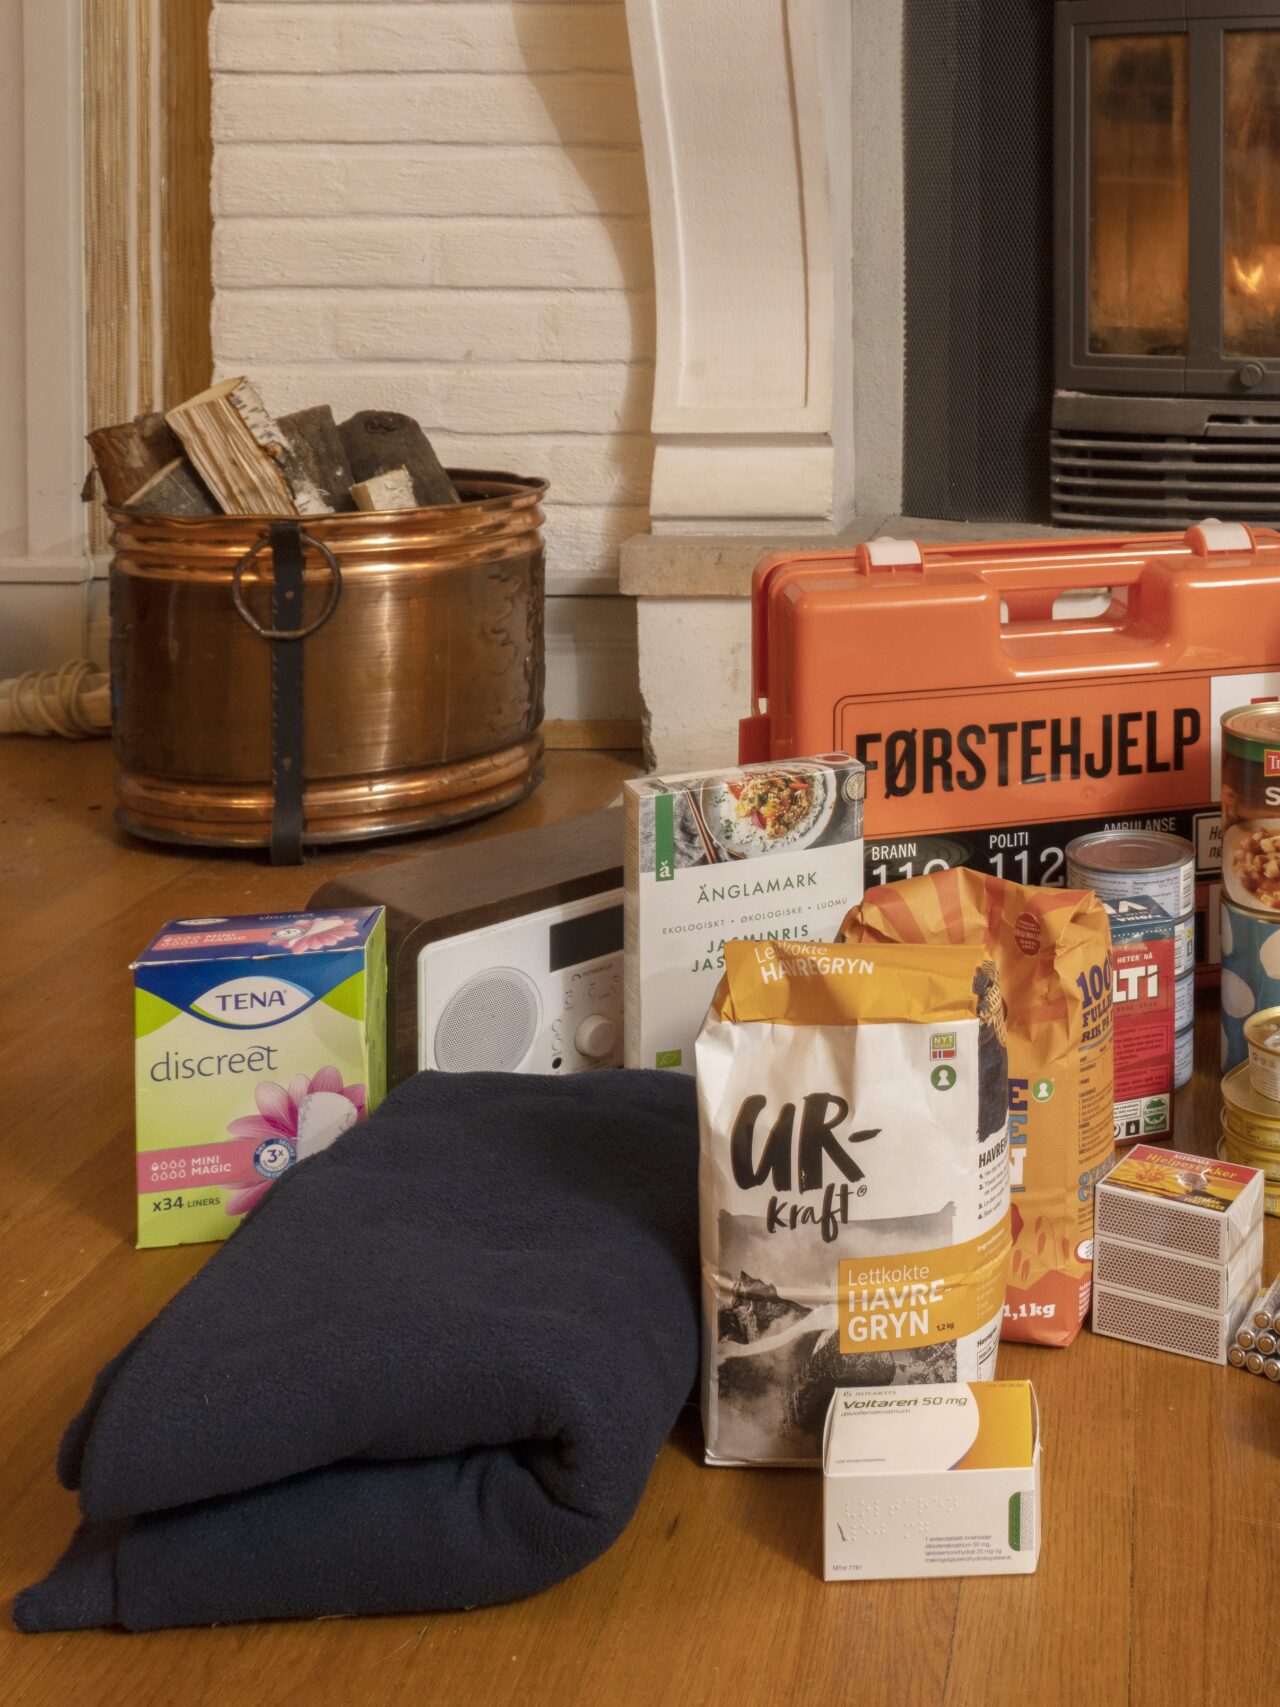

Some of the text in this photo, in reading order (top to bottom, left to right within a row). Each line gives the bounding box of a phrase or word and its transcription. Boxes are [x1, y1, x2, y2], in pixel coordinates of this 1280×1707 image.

[855, 707, 1201, 800] FØRSTEHJELP
[989, 832, 1029, 849] POLITI
[872, 843, 917, 861] BRANN
[662, 898, 848, 936] EKOLOGISKT ØKOLOGISKE LUOMU
[1118, 952, 1153, 963] HETER NÅ
[760, 956, 875, 984] HAVREGRYN
[215, 991, 286, 1011] TENA
[934, 1036, 953, 1044] NYT
[1081, 1027, 1101, 1043] RIK
[150, 1045, 278, 1082] discreet
[191, 1155, 219, 1165] MINI
[191, 1163, 231, 1176] MAGIC
[152, 1197, 220, 1212] x34 LINERS
[766, 1183, 855, 1243] kraft
[848, 1264, 930, 1287] Lettkokte
[848, 1279, 952, 1312] HAVRE-
[848, 1309, 929, 1343] GRYN
[936, 1321, 955, 1331] 1,2 kg
[843, 1397, 967, 1409] Voltaren 50 mg
